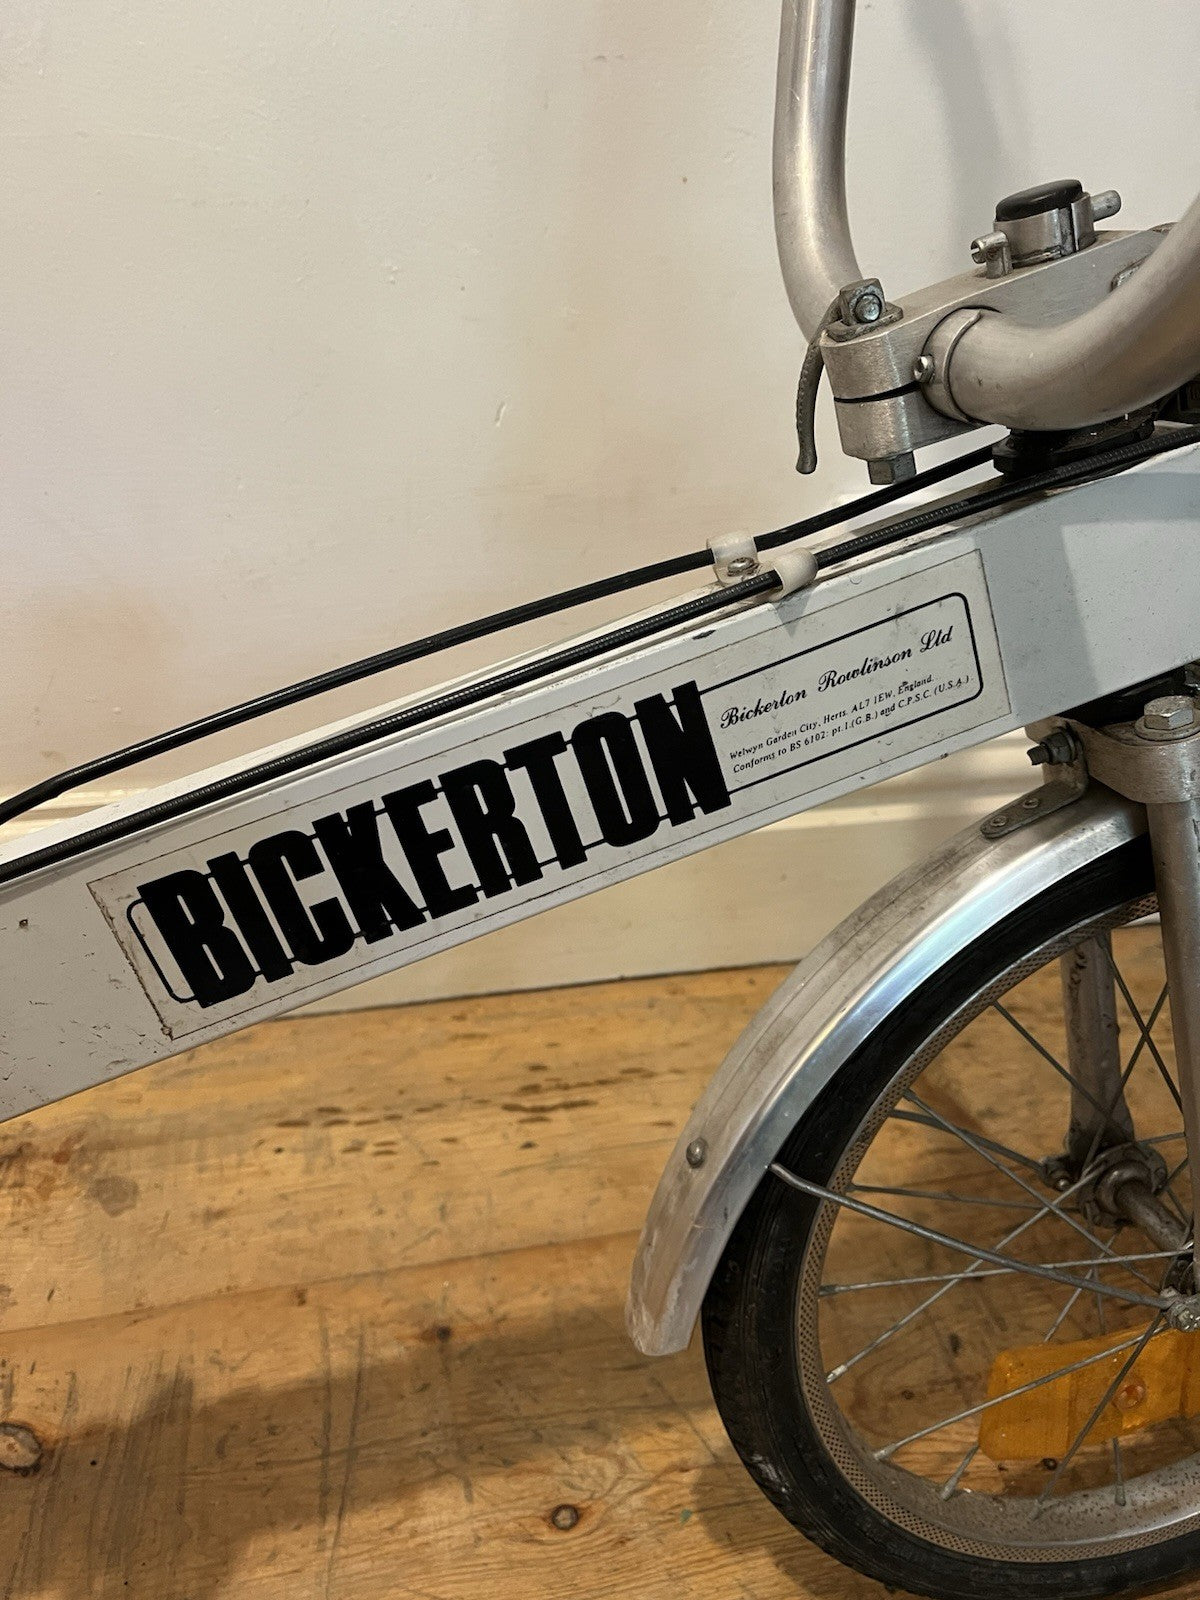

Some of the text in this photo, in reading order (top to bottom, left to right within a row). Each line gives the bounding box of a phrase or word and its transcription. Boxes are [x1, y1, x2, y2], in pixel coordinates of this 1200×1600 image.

[720, 625, 953, 729] Bickerton Rowlinson Ltd
[730, 743, 764, 760] Welwyn
[766, 729, 797, 746] Garden
[851, 699, 870, 713] AL7
[733, 752, 776, 773] Conforms
[778, 748, 787, 756] to
[790, 740, 802, 752] BS
[880, 703, 896, 716] and
[137, 680, 731, 1009] BICKERTON
